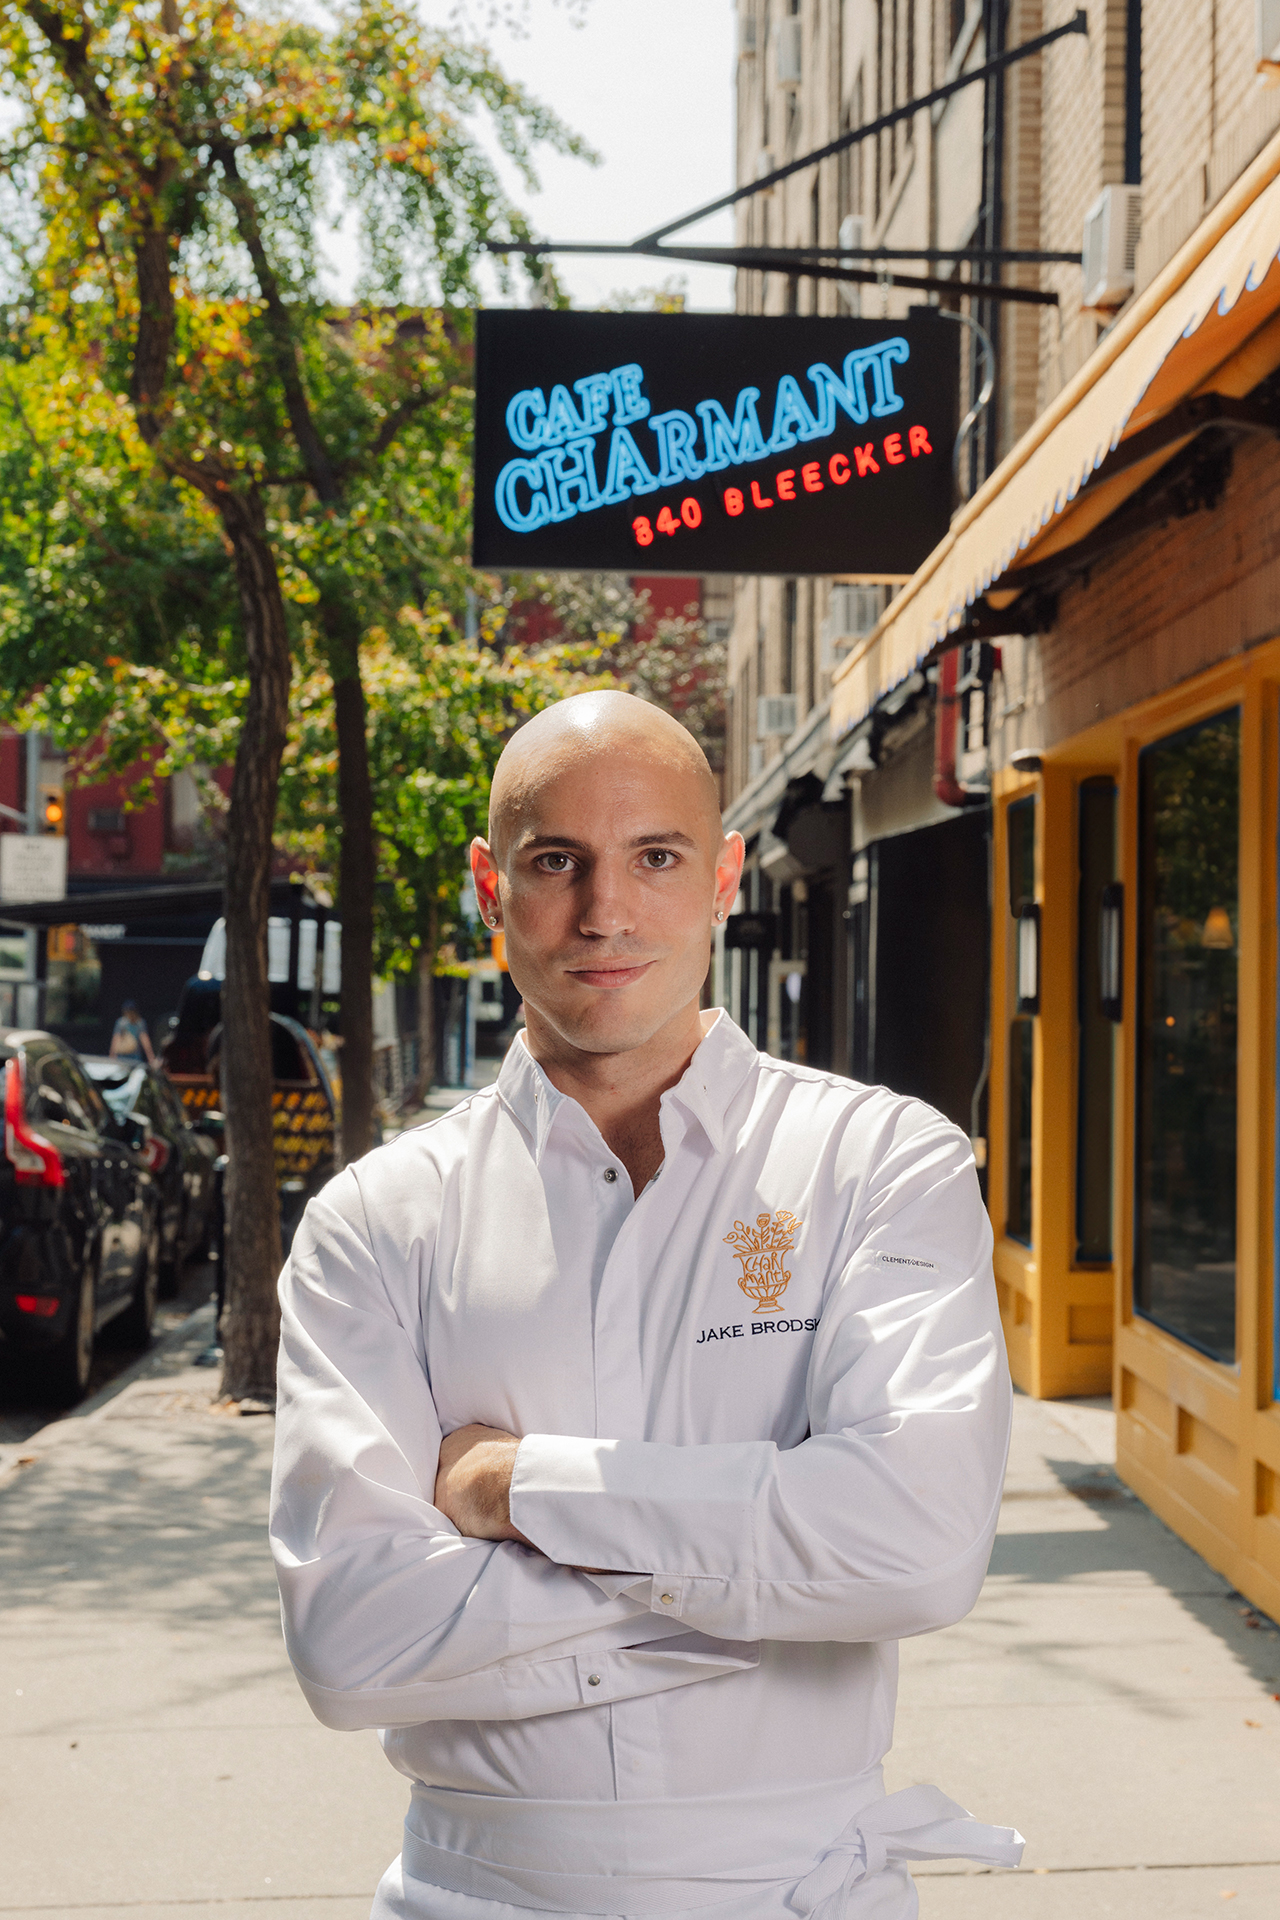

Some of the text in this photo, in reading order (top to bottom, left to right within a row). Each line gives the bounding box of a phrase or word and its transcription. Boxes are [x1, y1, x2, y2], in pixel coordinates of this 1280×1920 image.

[495, 337, 910, 533] CHARMANT
[506, 363, 650, 451] CAFE
[631, 425, 933, 547] 340 BLEECKER
[696, 1324, 744, 1344] JAKE
